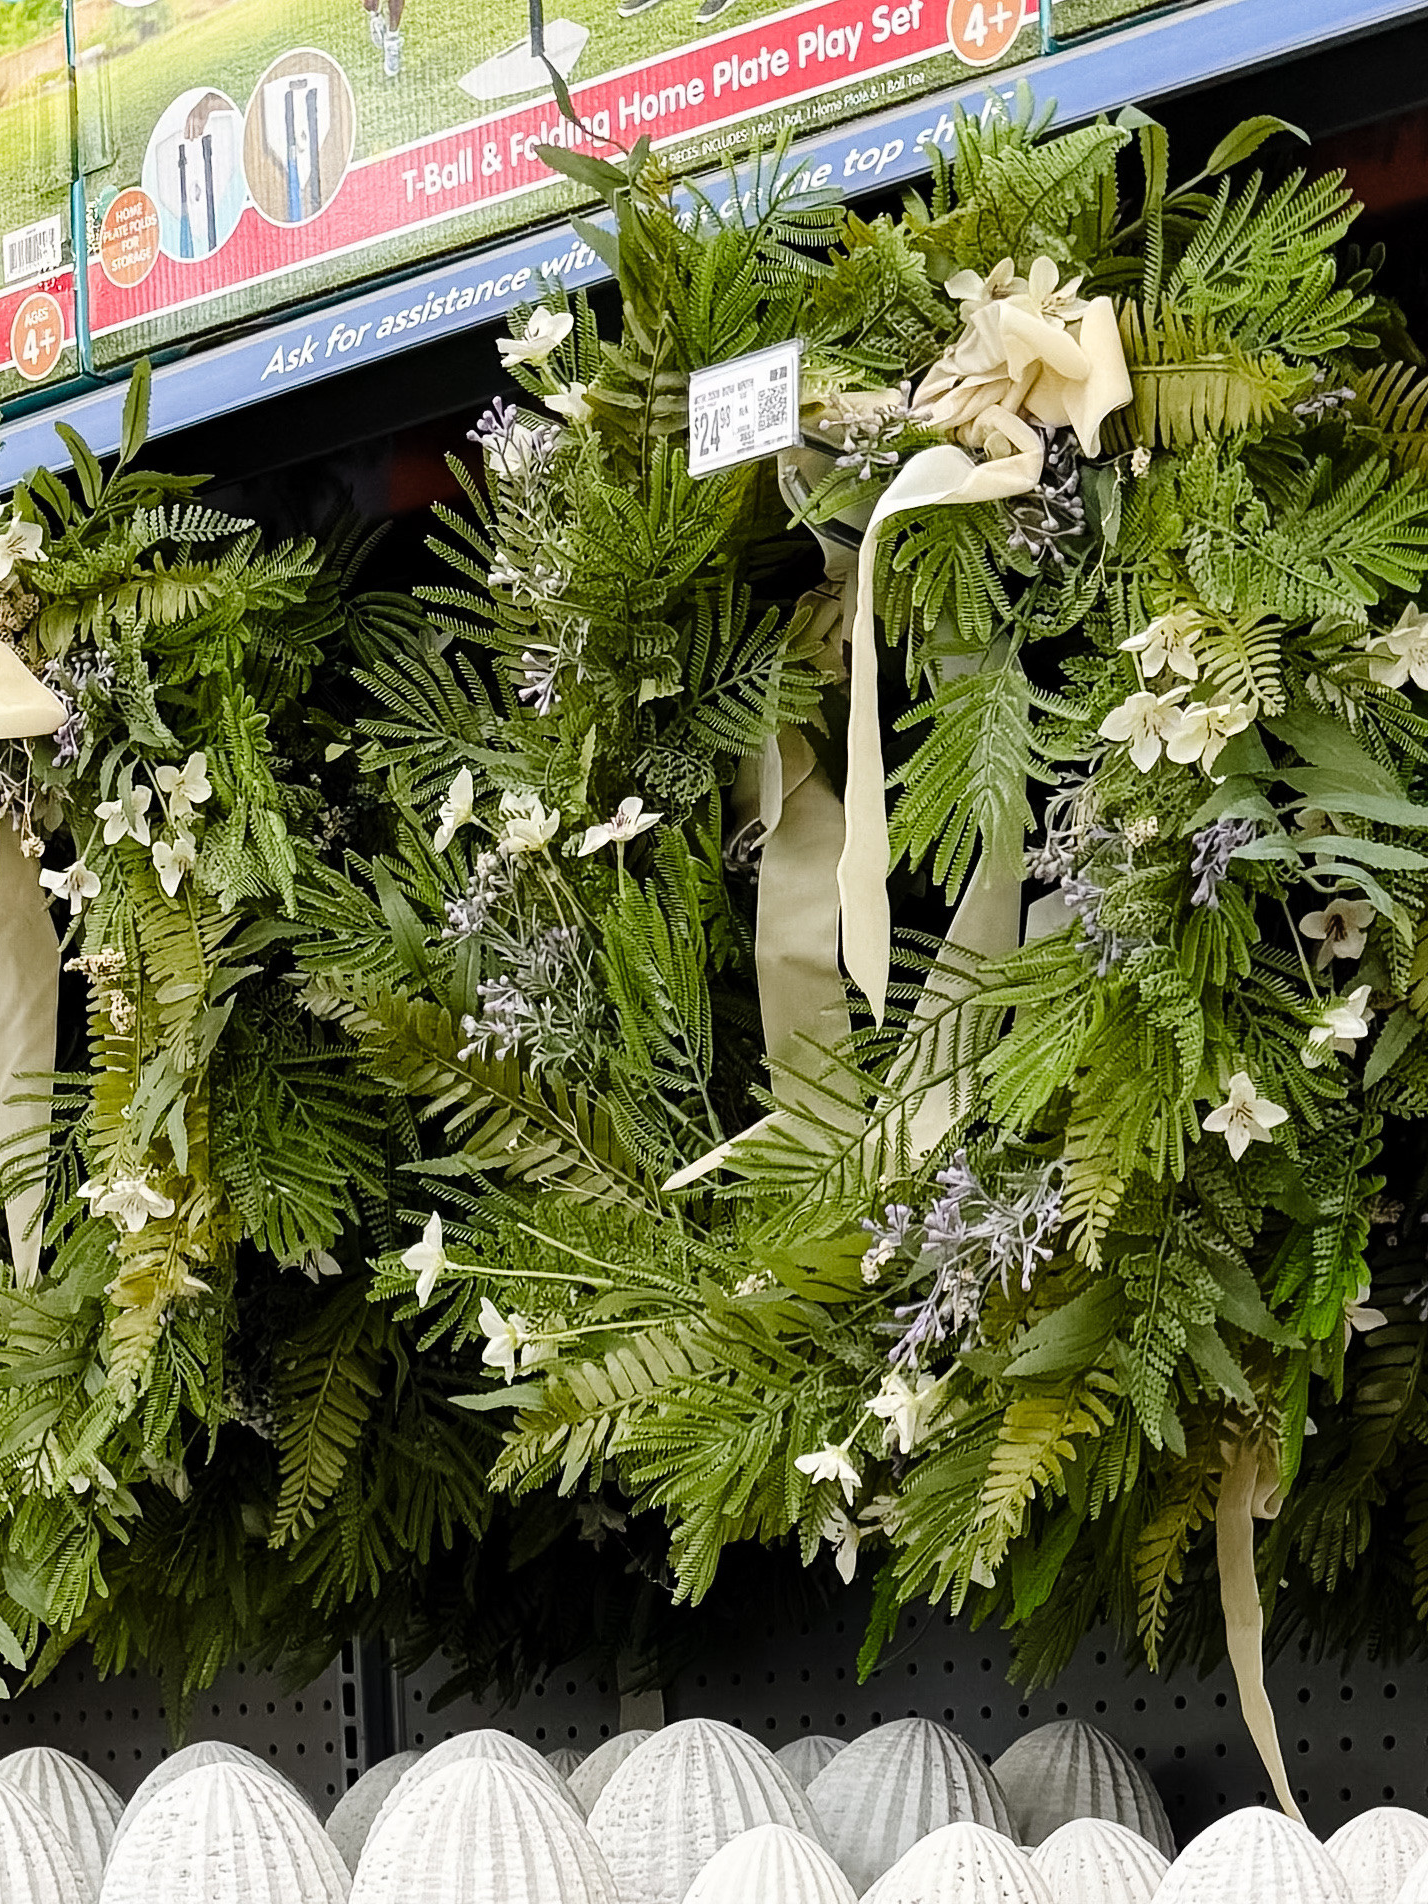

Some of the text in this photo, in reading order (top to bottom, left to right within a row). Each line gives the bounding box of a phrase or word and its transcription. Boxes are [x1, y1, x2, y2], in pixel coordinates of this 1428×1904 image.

[963, 5, 1014, 48] 4+
[401, 156, 474, 204] T-Ball
[481, 143, 503, 177] &
[618, 75, 706, 130] Home
[712, 47, 790, 99] Plate
[797, 24, 863, 70] Play
[871, 0, 925, 44] Set
[260, 337, 320, 382] Ask
[324, 320, 371, 357] for
[375, 265, 532, 339] assistance
[843, 138, 904, 180] top
[24, 306, 50, 329] AGES
[23, 329, 57, 366] 4+
